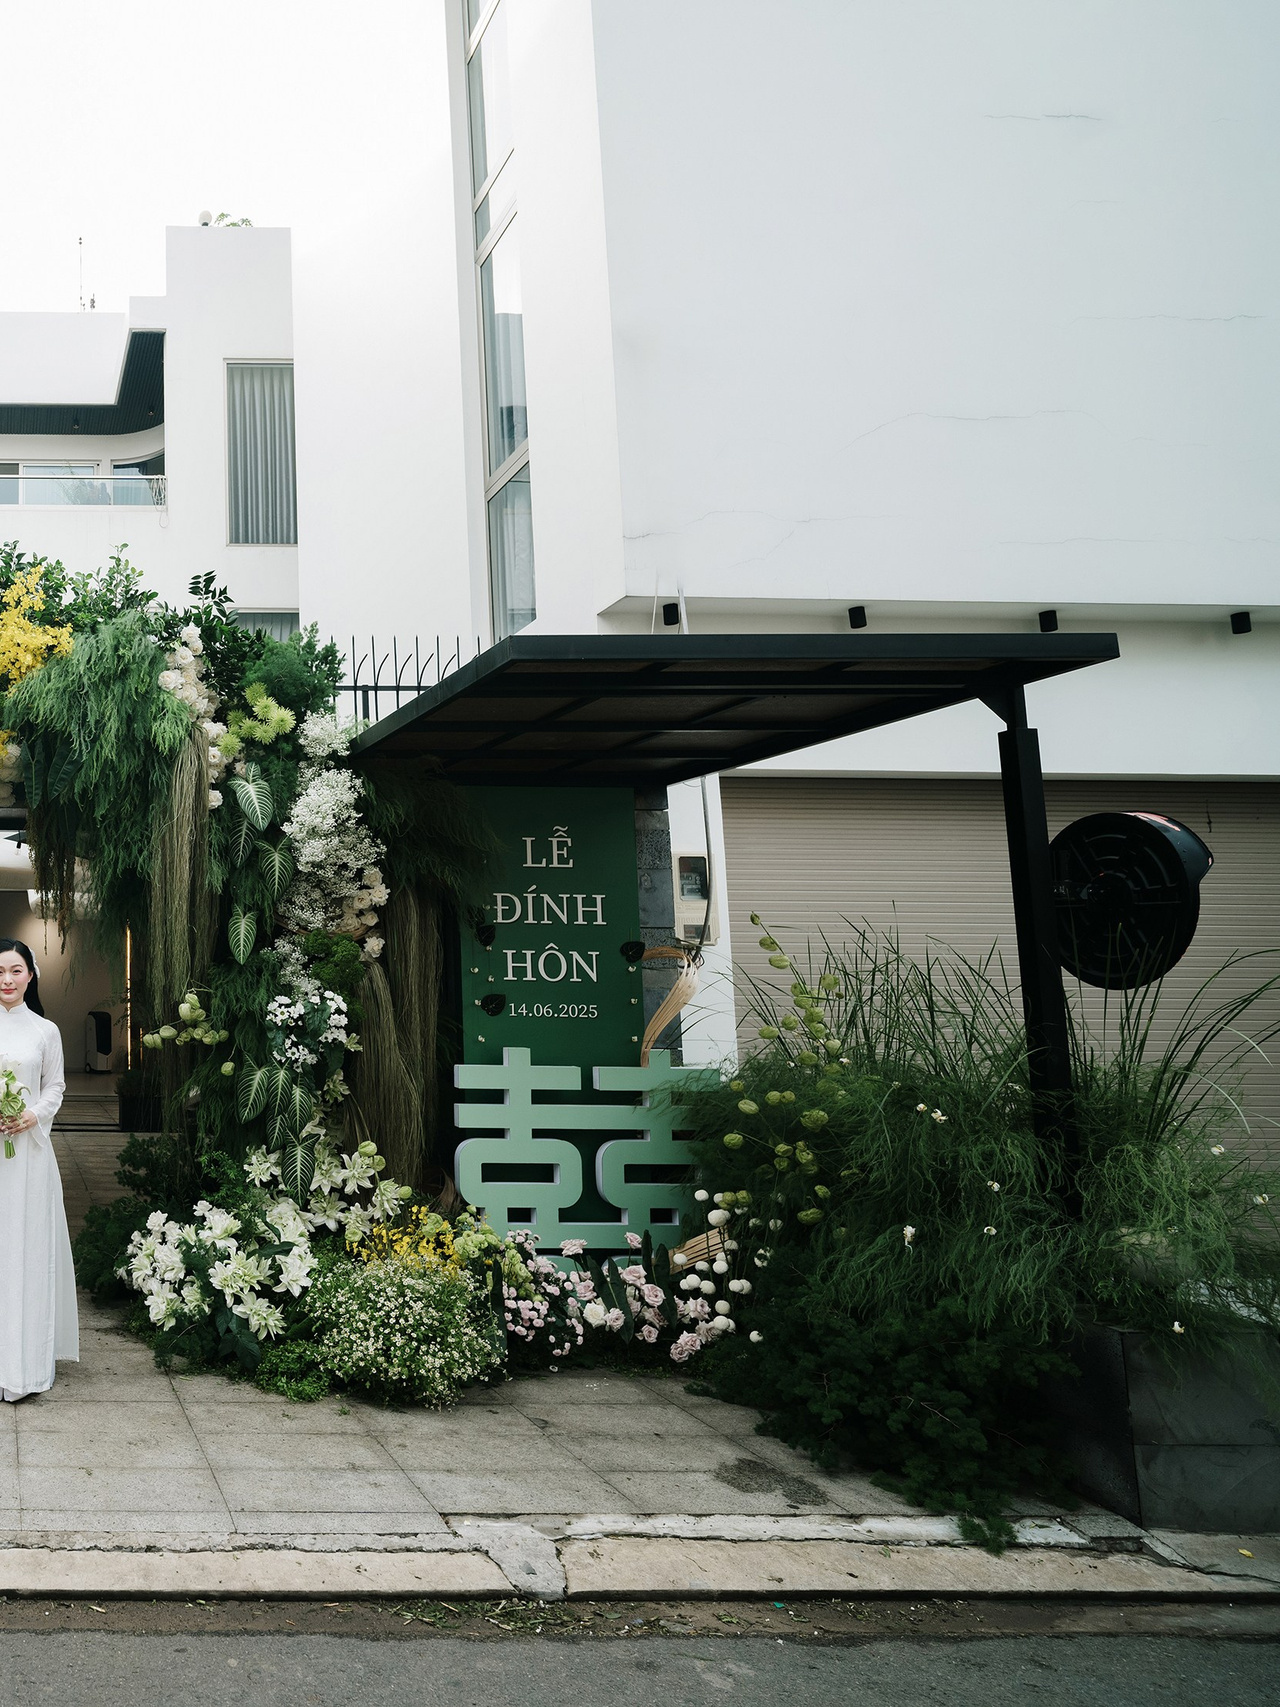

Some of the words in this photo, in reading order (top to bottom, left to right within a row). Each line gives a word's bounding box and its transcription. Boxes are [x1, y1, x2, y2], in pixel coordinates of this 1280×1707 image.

[522, 825, 574, 868] LỄ
[492, 884, 607, 925] ĐÍNH
[502, 942, 600, 982] HÔN
[509, 1003, 598, 1018] 14.06.2025
